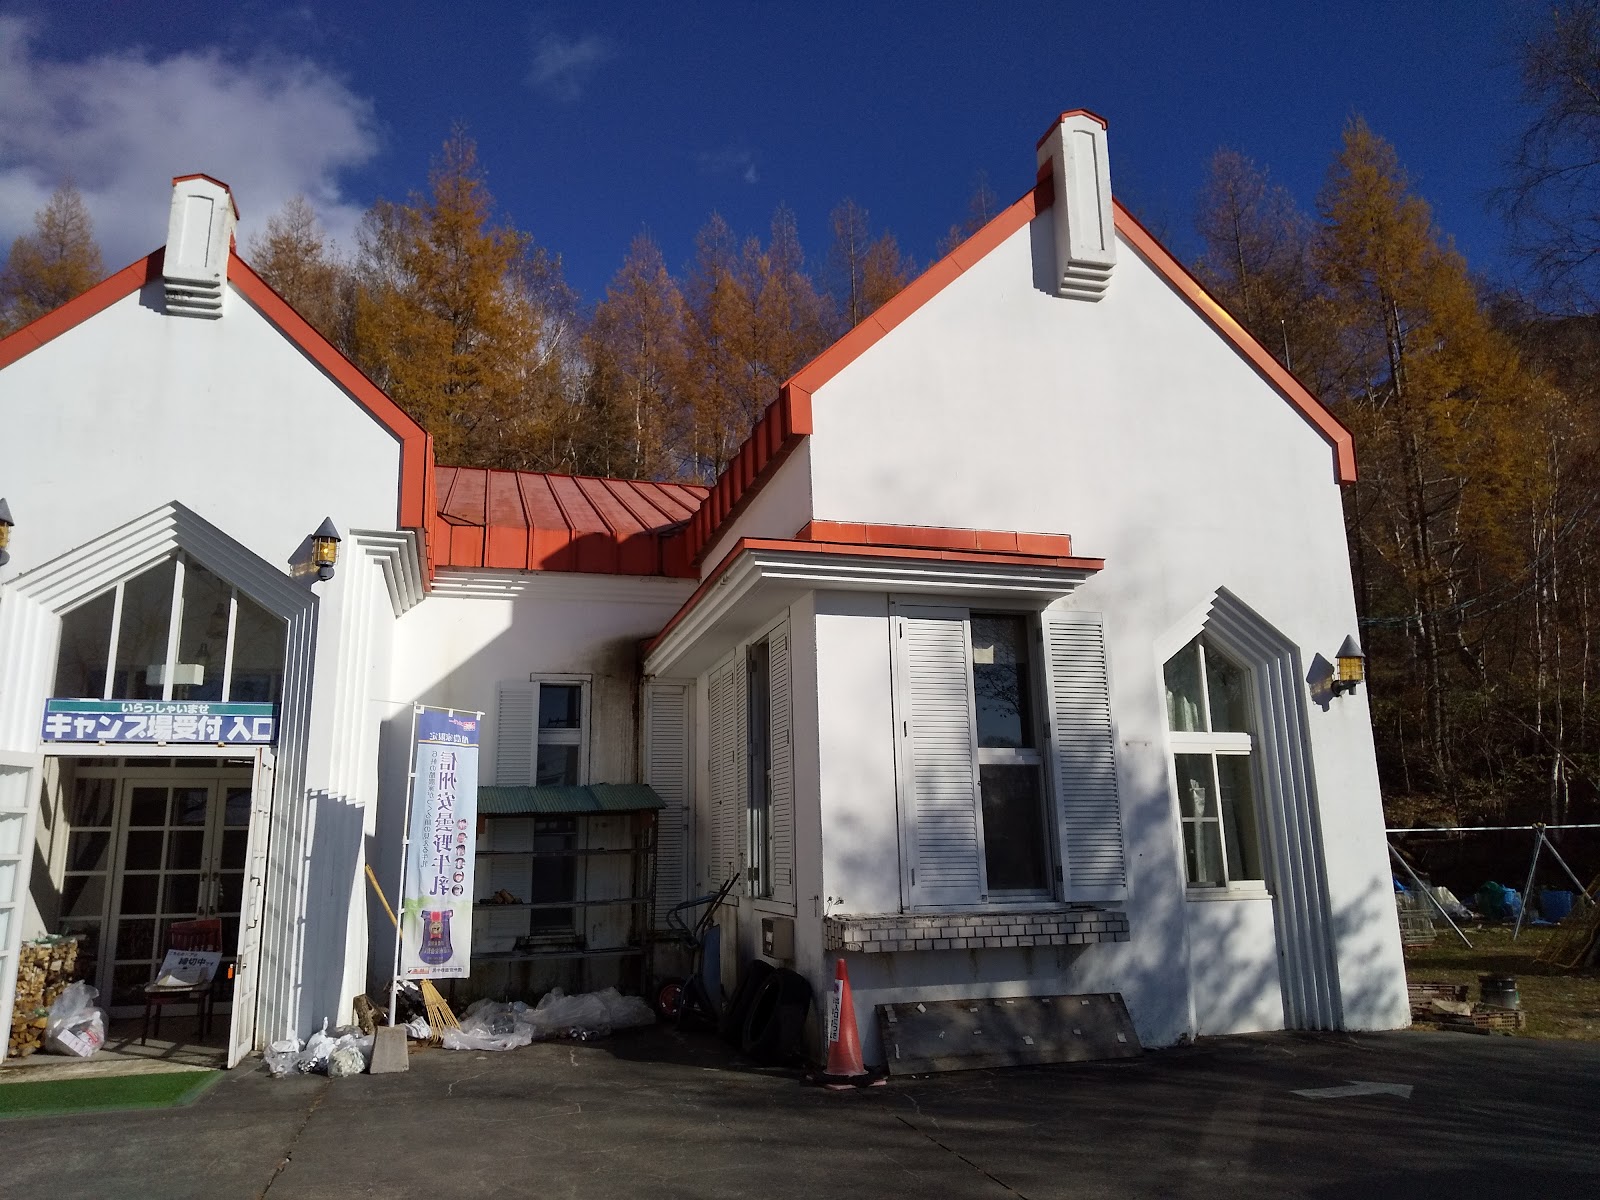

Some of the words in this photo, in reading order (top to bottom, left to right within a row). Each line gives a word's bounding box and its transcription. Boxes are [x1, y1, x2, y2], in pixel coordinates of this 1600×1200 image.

[121, 703, 210, 714] いらっしゃいませ
[45, 713, 223, 741] キャンプ場受付
[226, 716, 275, 741] 入口
